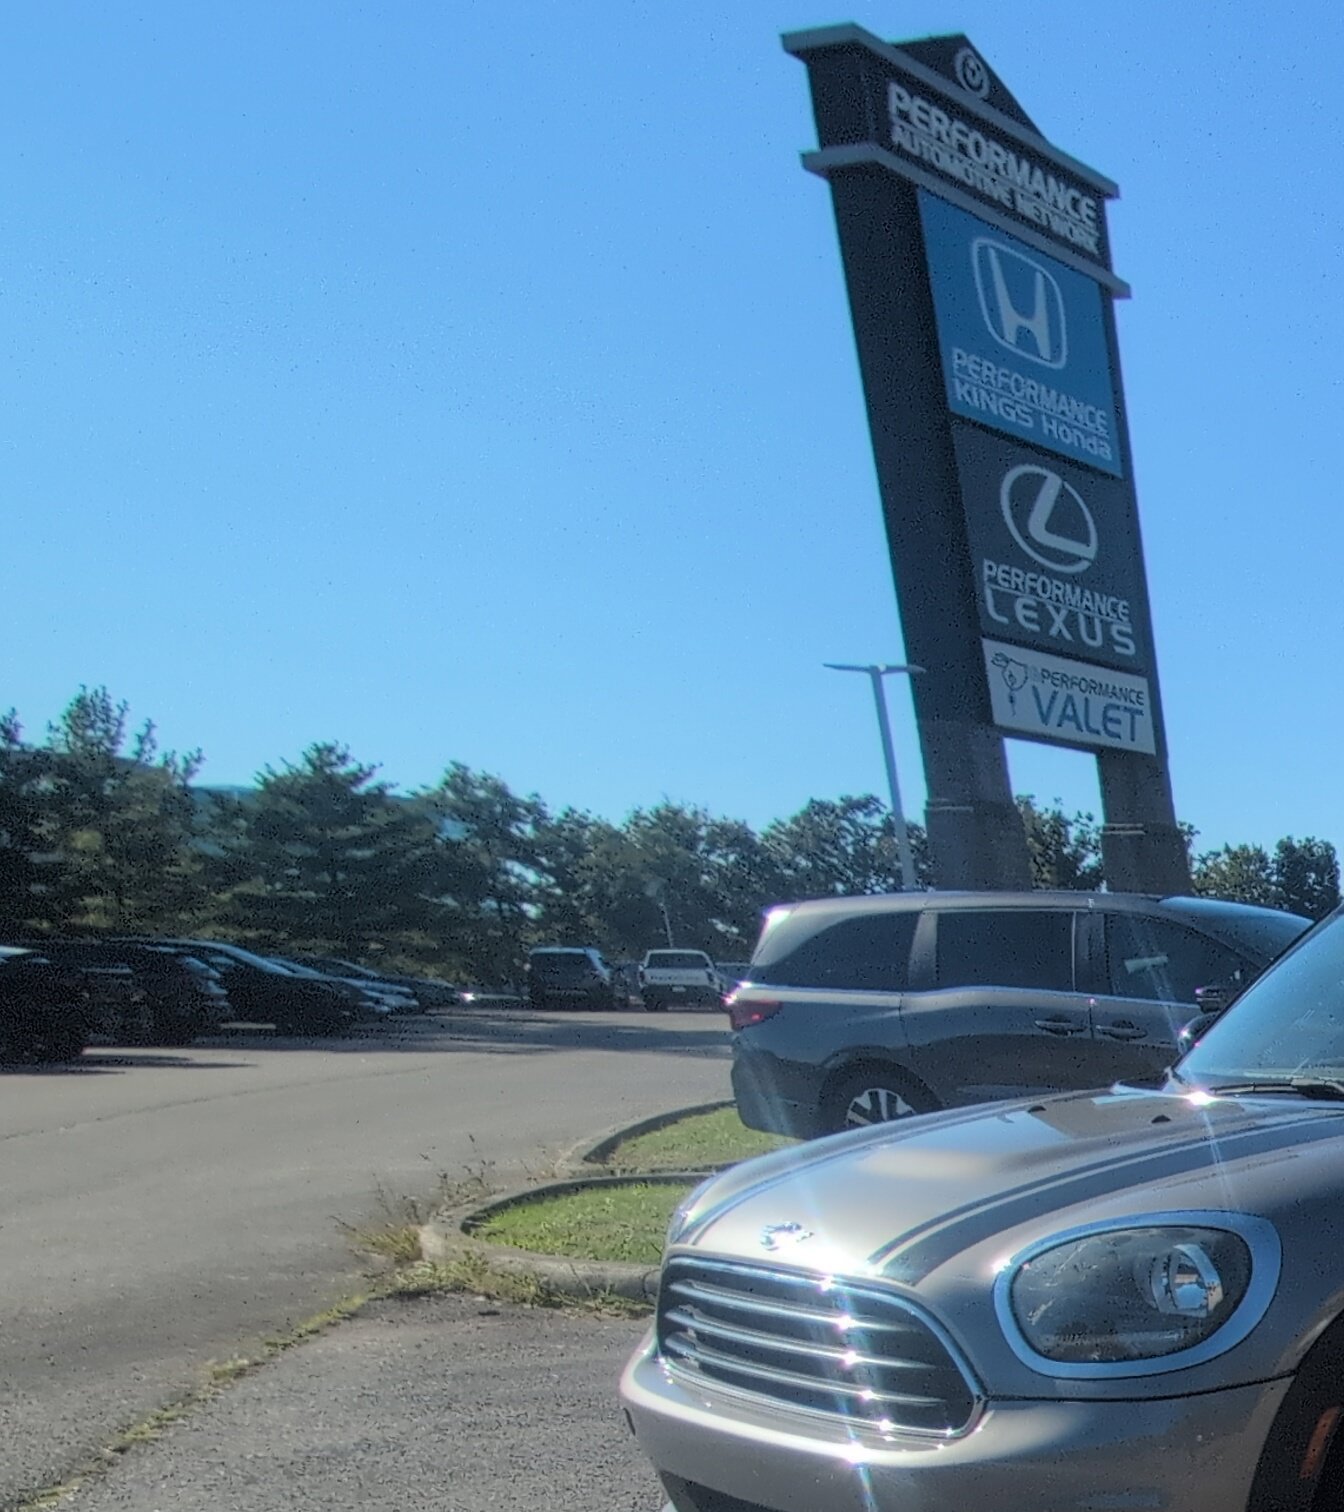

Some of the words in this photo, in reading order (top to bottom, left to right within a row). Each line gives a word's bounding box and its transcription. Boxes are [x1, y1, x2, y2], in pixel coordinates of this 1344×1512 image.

[887, 81, 1098, 225] PERFORMANCE
[952, 348, 1107, 433] PERFORMANCE
[953, 378, 1033, 428] KINGS
[983, 558, 1131, 621] PERFORMANCE
[984, 586, 1136, 655] LEXUS
[1032, 685, 1144, 742] VALET
[1040, 668, 1144, 706] PERFORMANCE
